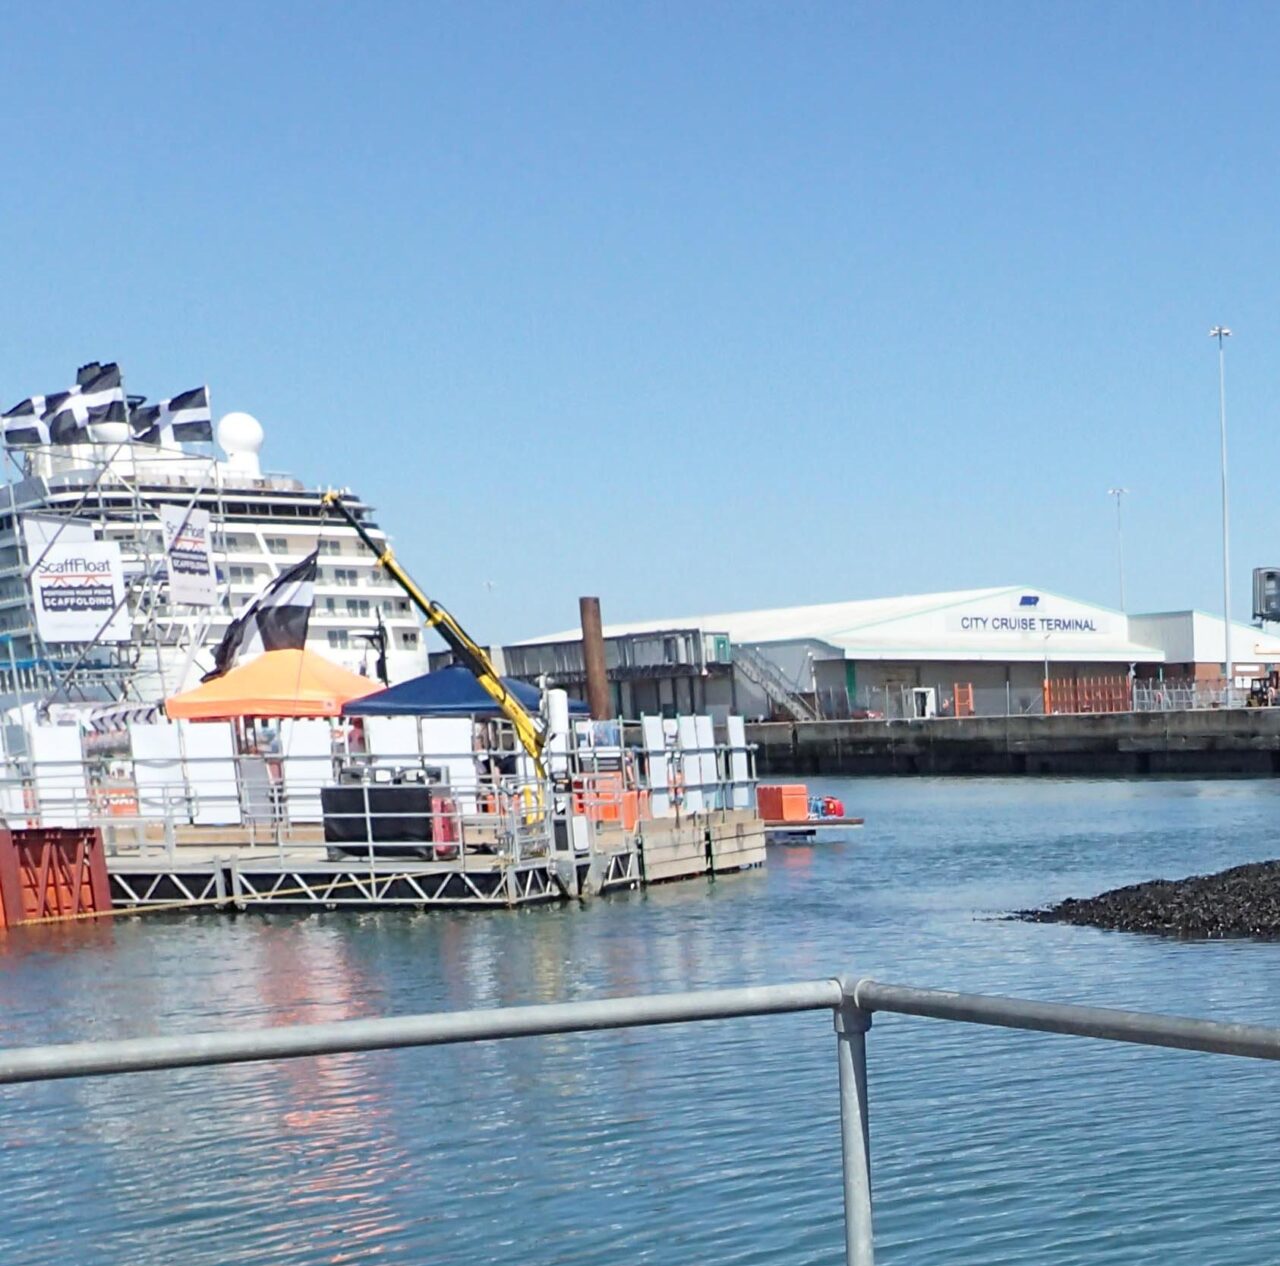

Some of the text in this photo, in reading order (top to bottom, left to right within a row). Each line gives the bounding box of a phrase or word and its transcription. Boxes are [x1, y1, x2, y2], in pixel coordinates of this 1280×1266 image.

[39, 558, 111, 573] ScaffFloat
[44, 597, 113, 607] SCAFFOLDING
[961, 617, 1096, 631] CITY CRUISE TERMINAL
